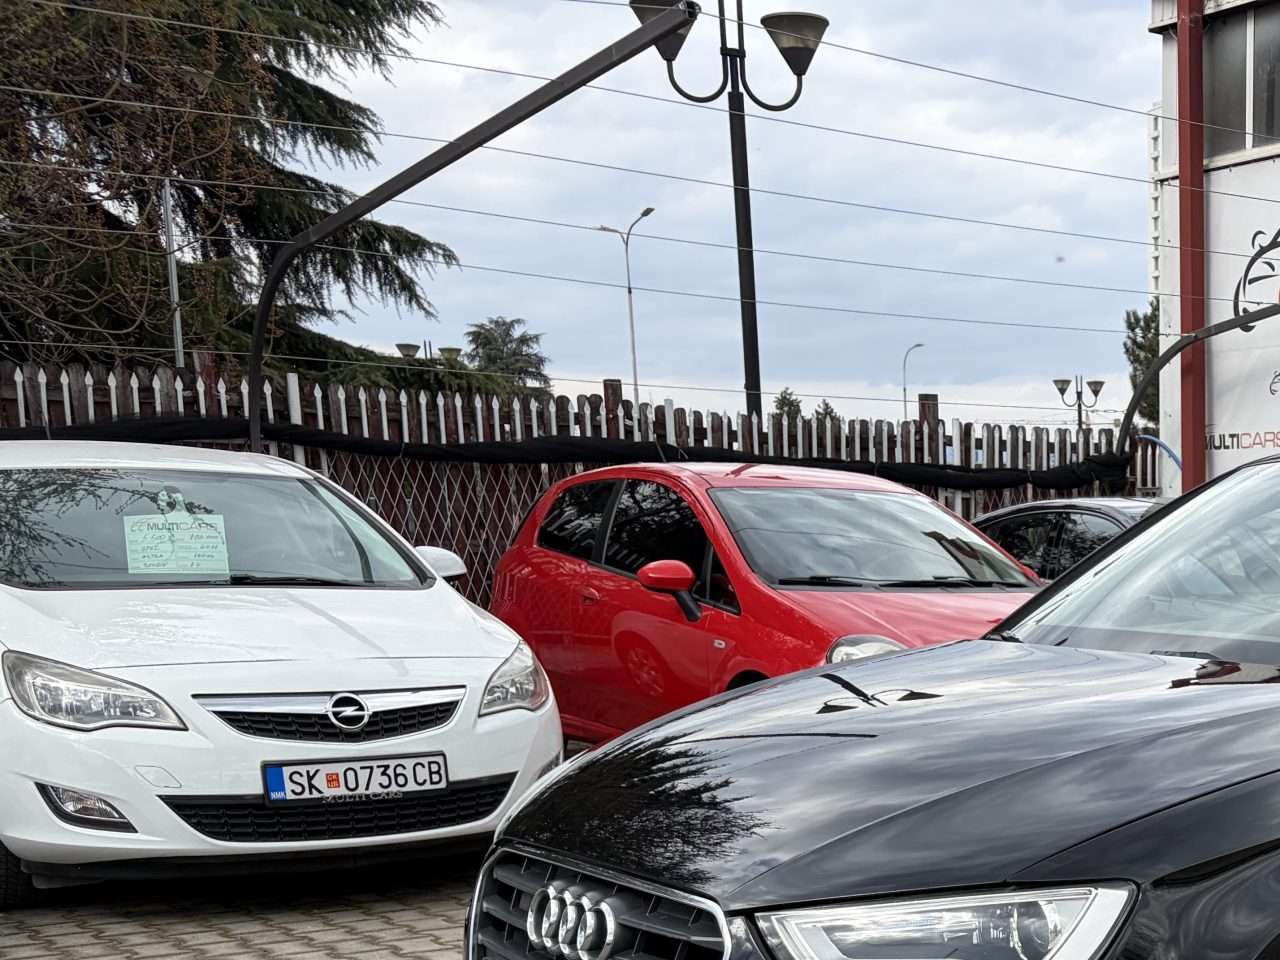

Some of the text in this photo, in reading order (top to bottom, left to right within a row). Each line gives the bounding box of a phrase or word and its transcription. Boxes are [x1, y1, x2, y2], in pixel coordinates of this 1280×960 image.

[288, 760, 443, 796] SK 0736 CB
[322, 790, 404, 804] MULTI CARS
